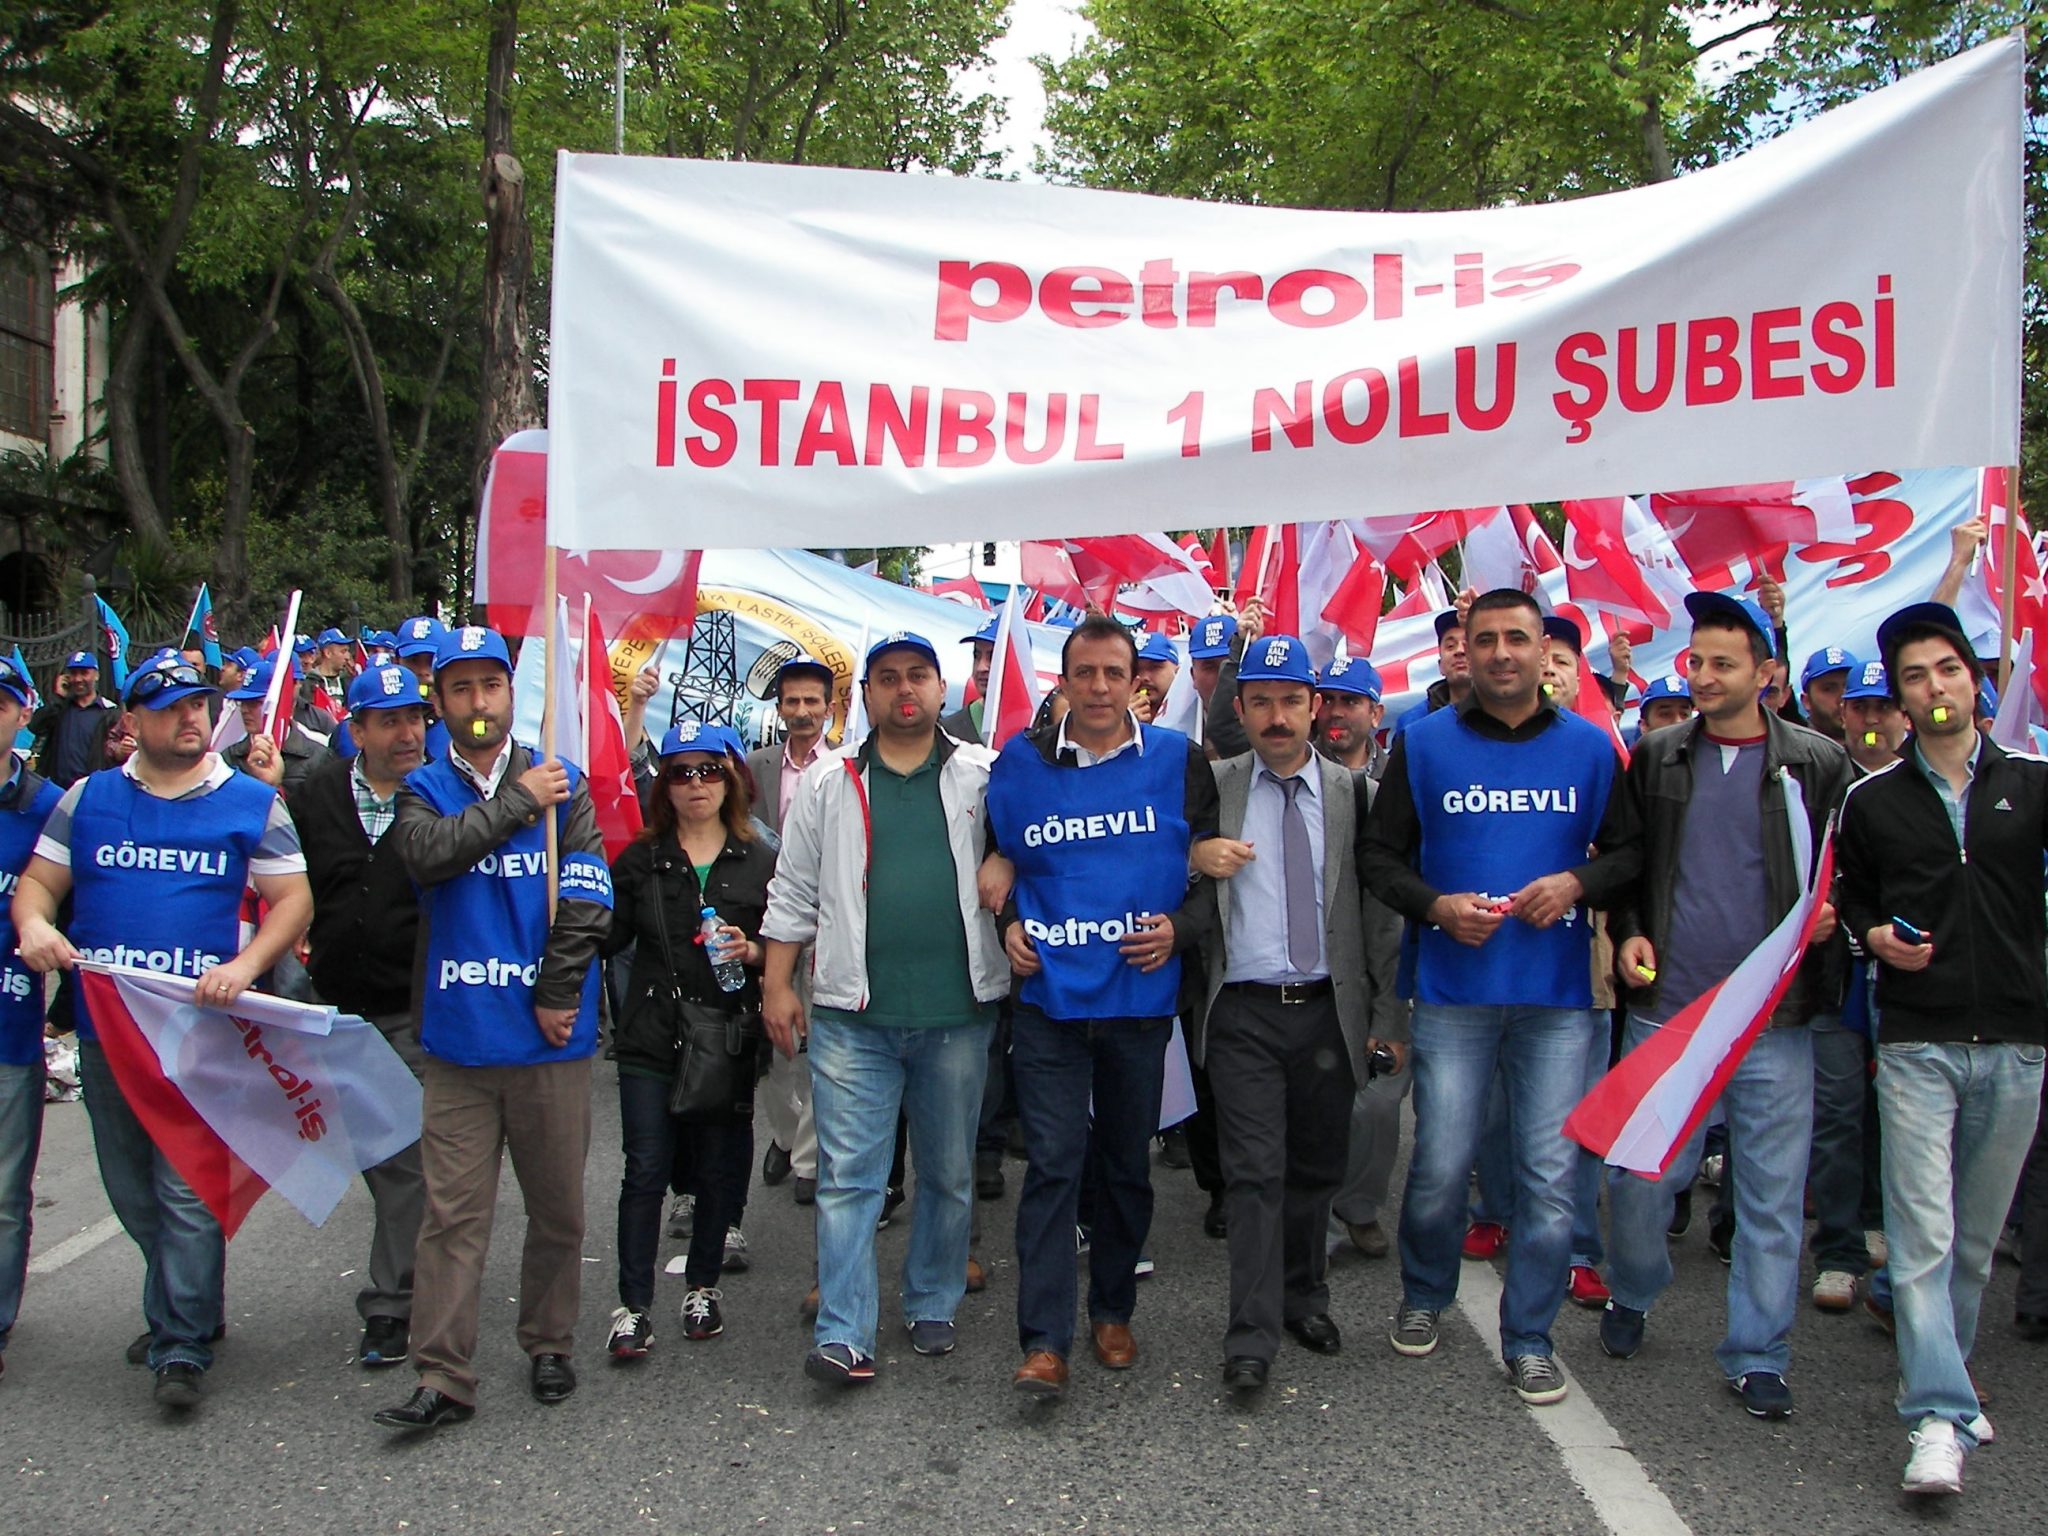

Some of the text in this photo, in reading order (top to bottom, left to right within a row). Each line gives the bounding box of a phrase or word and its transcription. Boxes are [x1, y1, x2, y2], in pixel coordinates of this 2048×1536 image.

[934, 253, 1582, 341] petrol-iş
[656, 274, 1897, 469] İSTANBUL 1 NOLU ŞUBESİ
[1442, 784, 1577, 814] GÖREVLİ
[1024, 806, 1156, 848] GÖREVLİ
[96, 840, 229, 877] GÖREVLİ
